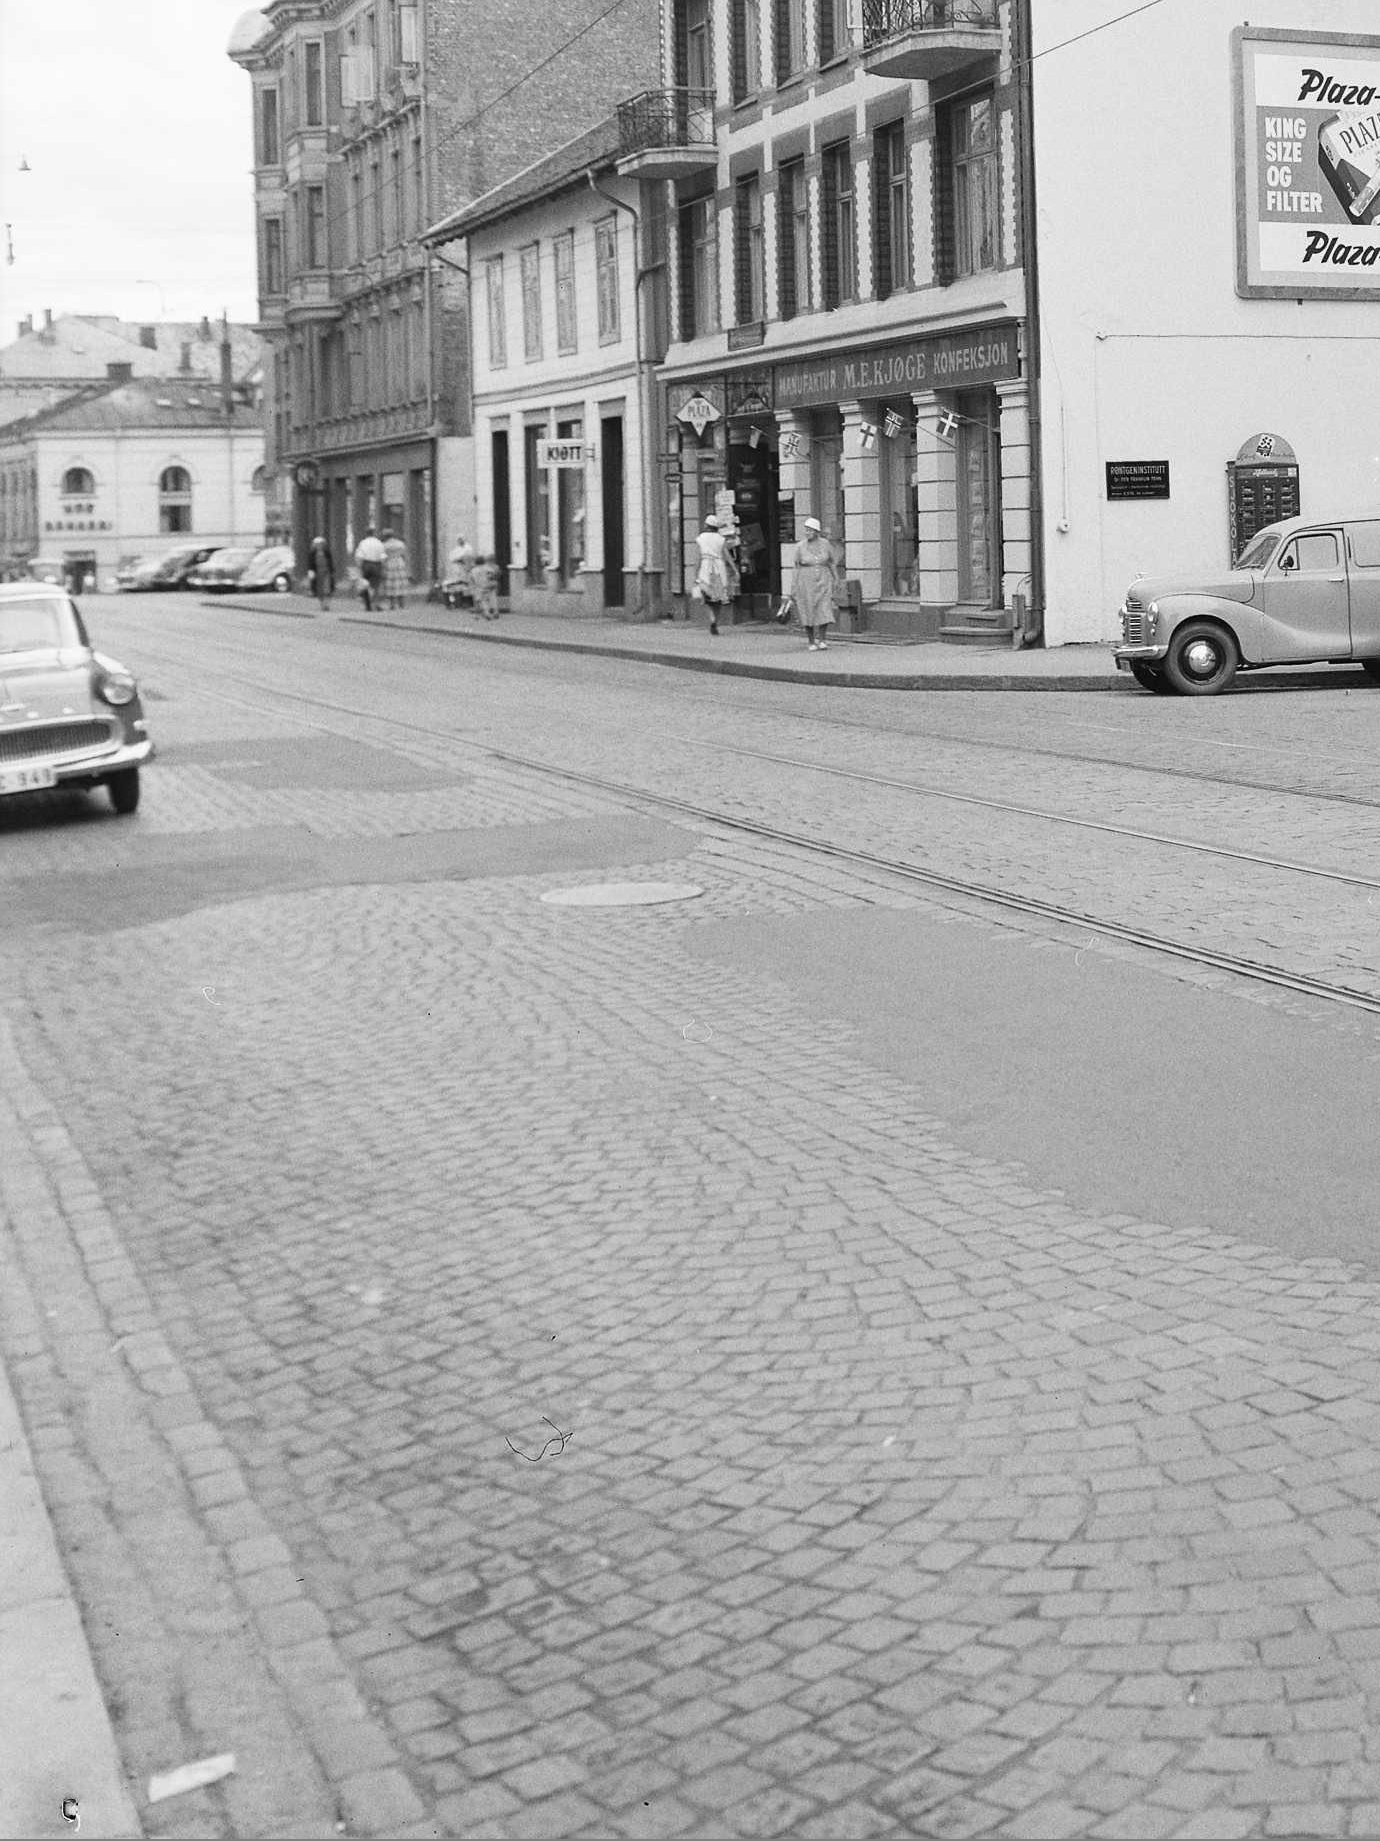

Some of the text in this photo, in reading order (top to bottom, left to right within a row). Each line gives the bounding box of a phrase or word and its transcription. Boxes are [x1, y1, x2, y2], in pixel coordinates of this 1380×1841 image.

[1265, 117, 1307, 139] KING
[1265, 141, 1302, 163] SIZE
[1266, 165, 1292, 187] OG
[1266, 190, 1323, 213] FILTER
[778, 369, 837, 397] MANUFAKTUR
[933, 342, 1008, 375] KONFEKSJON
[546, 446, 581, 461] KJØTT
